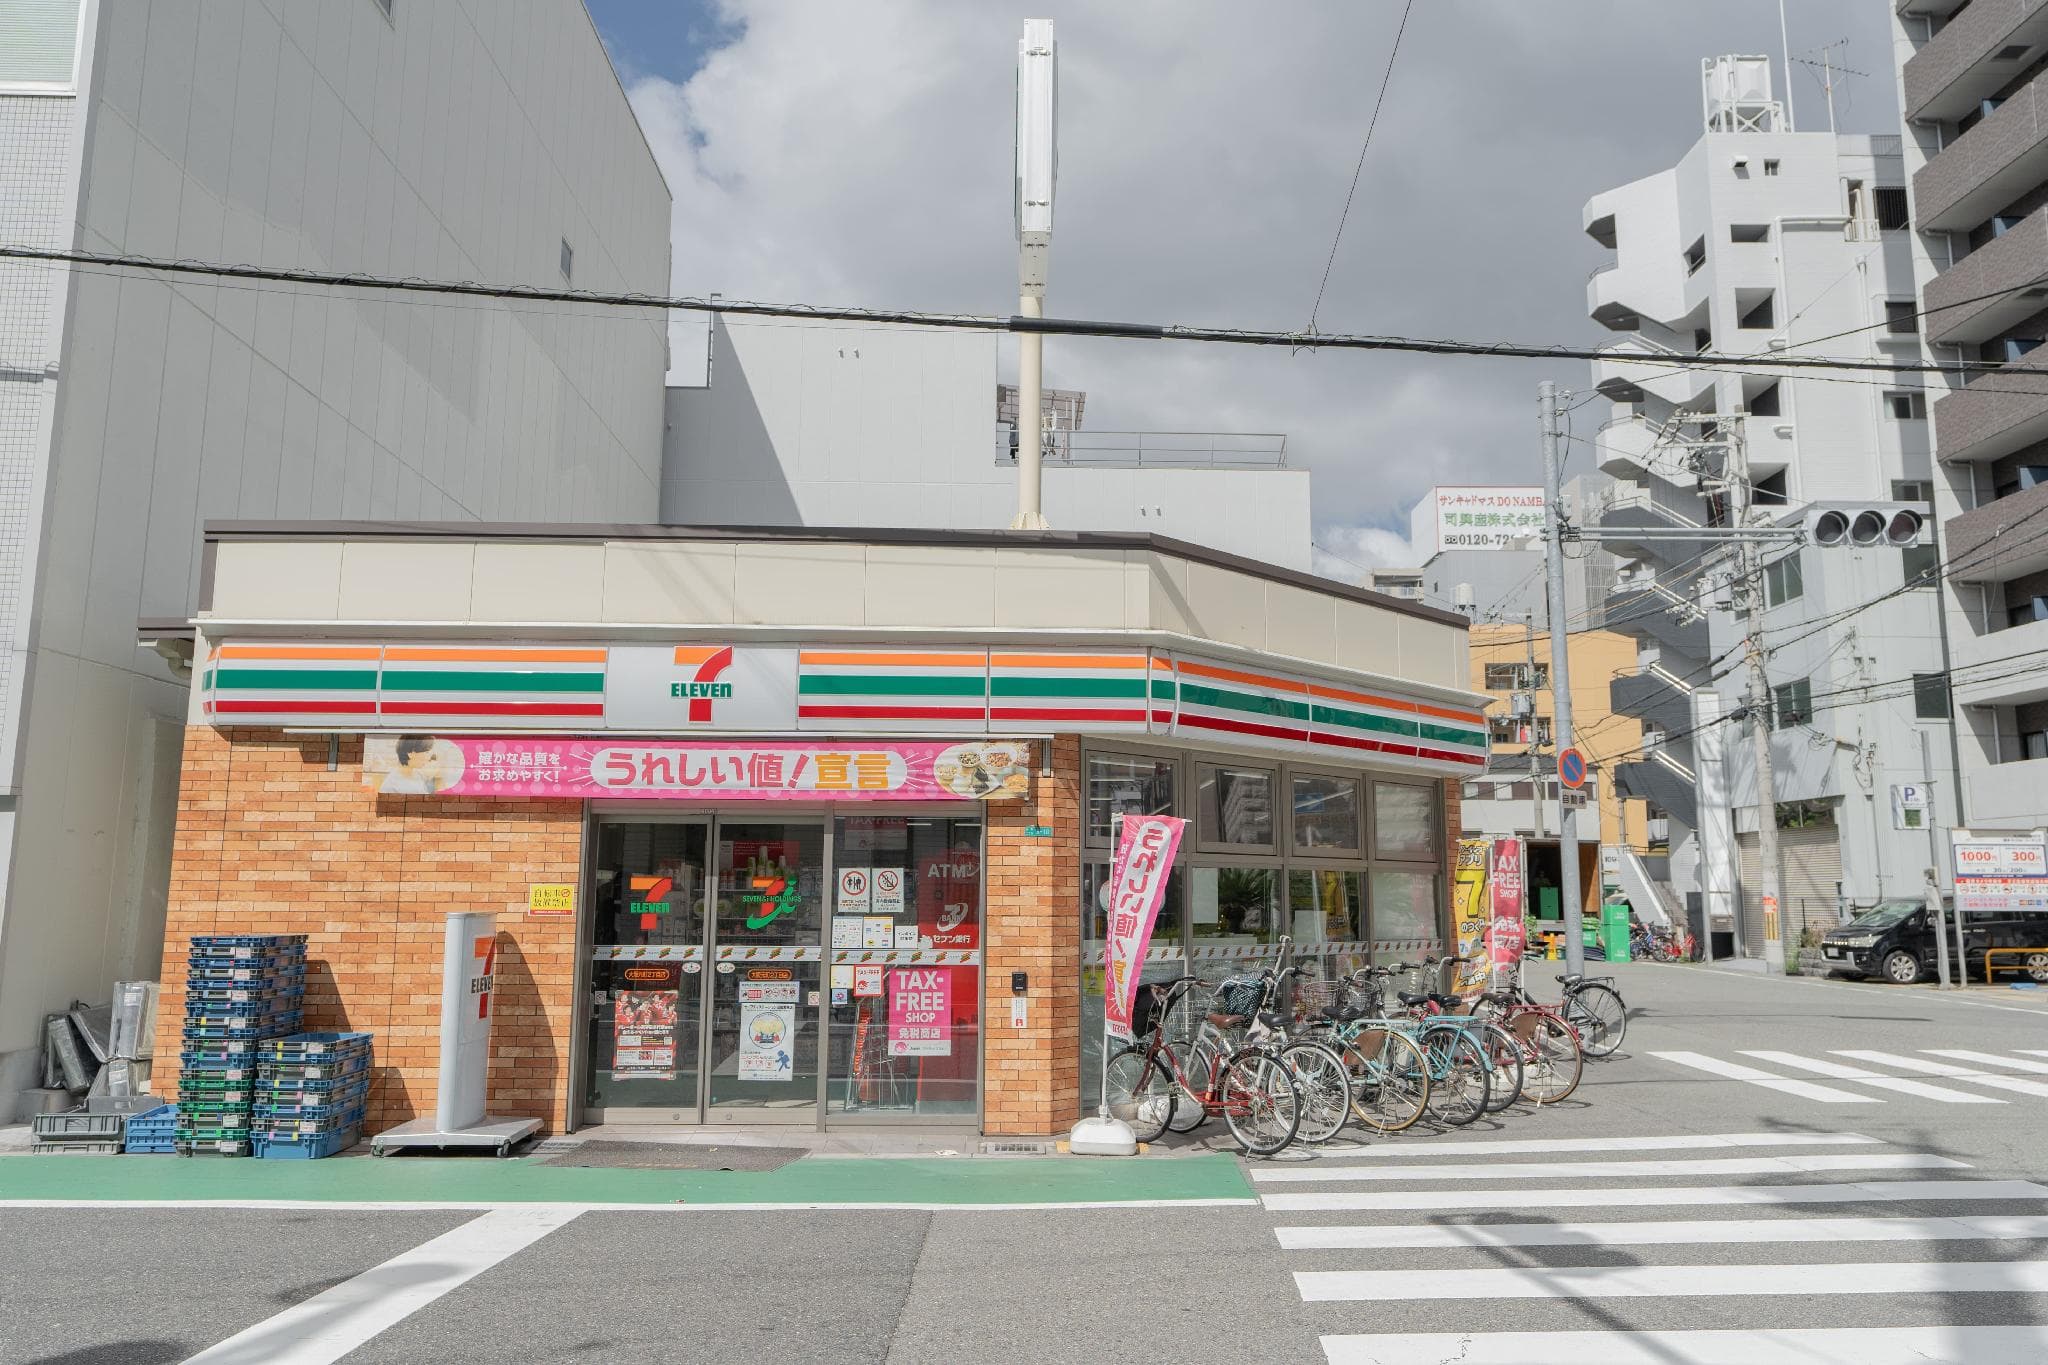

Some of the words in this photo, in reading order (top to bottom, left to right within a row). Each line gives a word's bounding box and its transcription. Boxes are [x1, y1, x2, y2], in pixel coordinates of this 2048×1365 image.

[1512, 496, 1544, 507] NAMB
[478, 751, 561, 766] 確かな品質を
[1562, 794, 1586, 805] 自動車
[1904, 787, 1916, 802] P
[927, 862, 967, 878] ATM
[534, 888, 561, 898] 自転車
[1455, 869, 1488, 919] 7
[1499, 889, 1518, 898] SHOP
[932, 934, 971, 944] セブン銀行
[896, 970, 944, 990] TAX-
[895, 992, 945, 1011] FREE
[905, 1012, 936, 1023] SHOP
[899, 1027, 941, 1039] 免税商店
